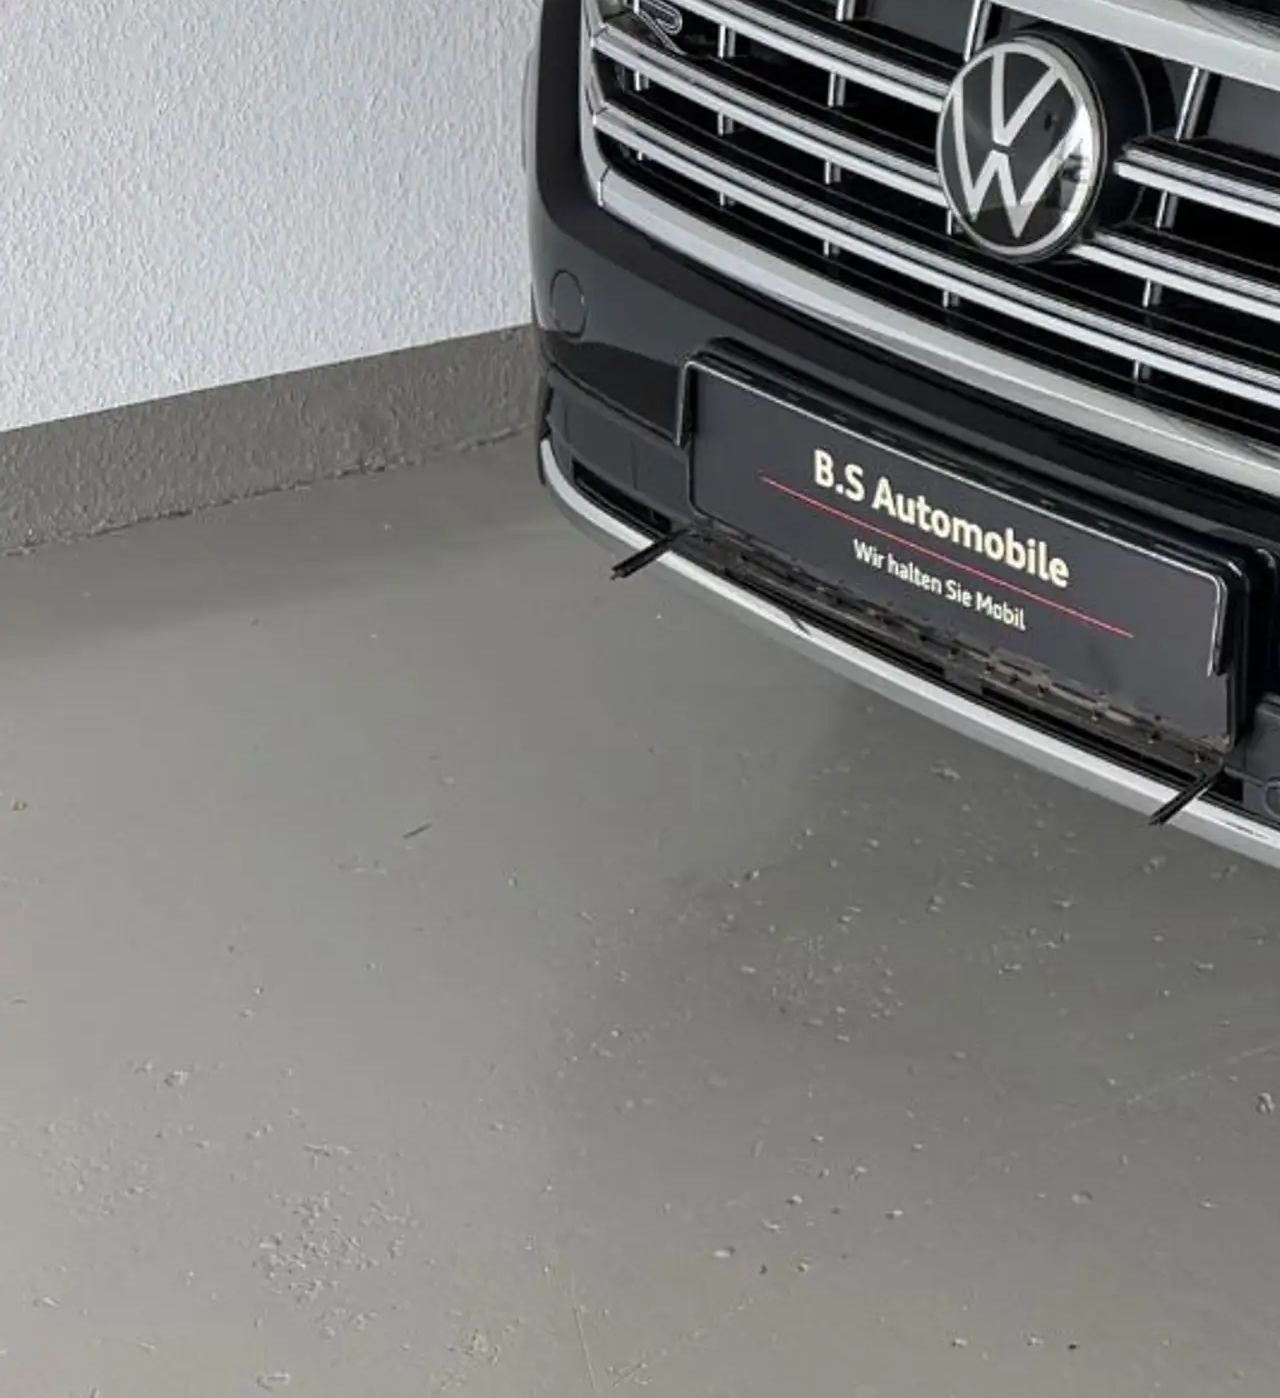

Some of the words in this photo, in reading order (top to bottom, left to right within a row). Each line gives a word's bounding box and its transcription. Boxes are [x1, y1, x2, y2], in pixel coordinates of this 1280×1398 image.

[813, 448, 866, 502] B.S
[870, 476, 1071, 589] Automobile
[852, 538, 886, 569] Wir
[886, 552, 943, 596] halten
[944, 578, 973, 608] Sie
[975, 591, 1027, 632] Mobil
